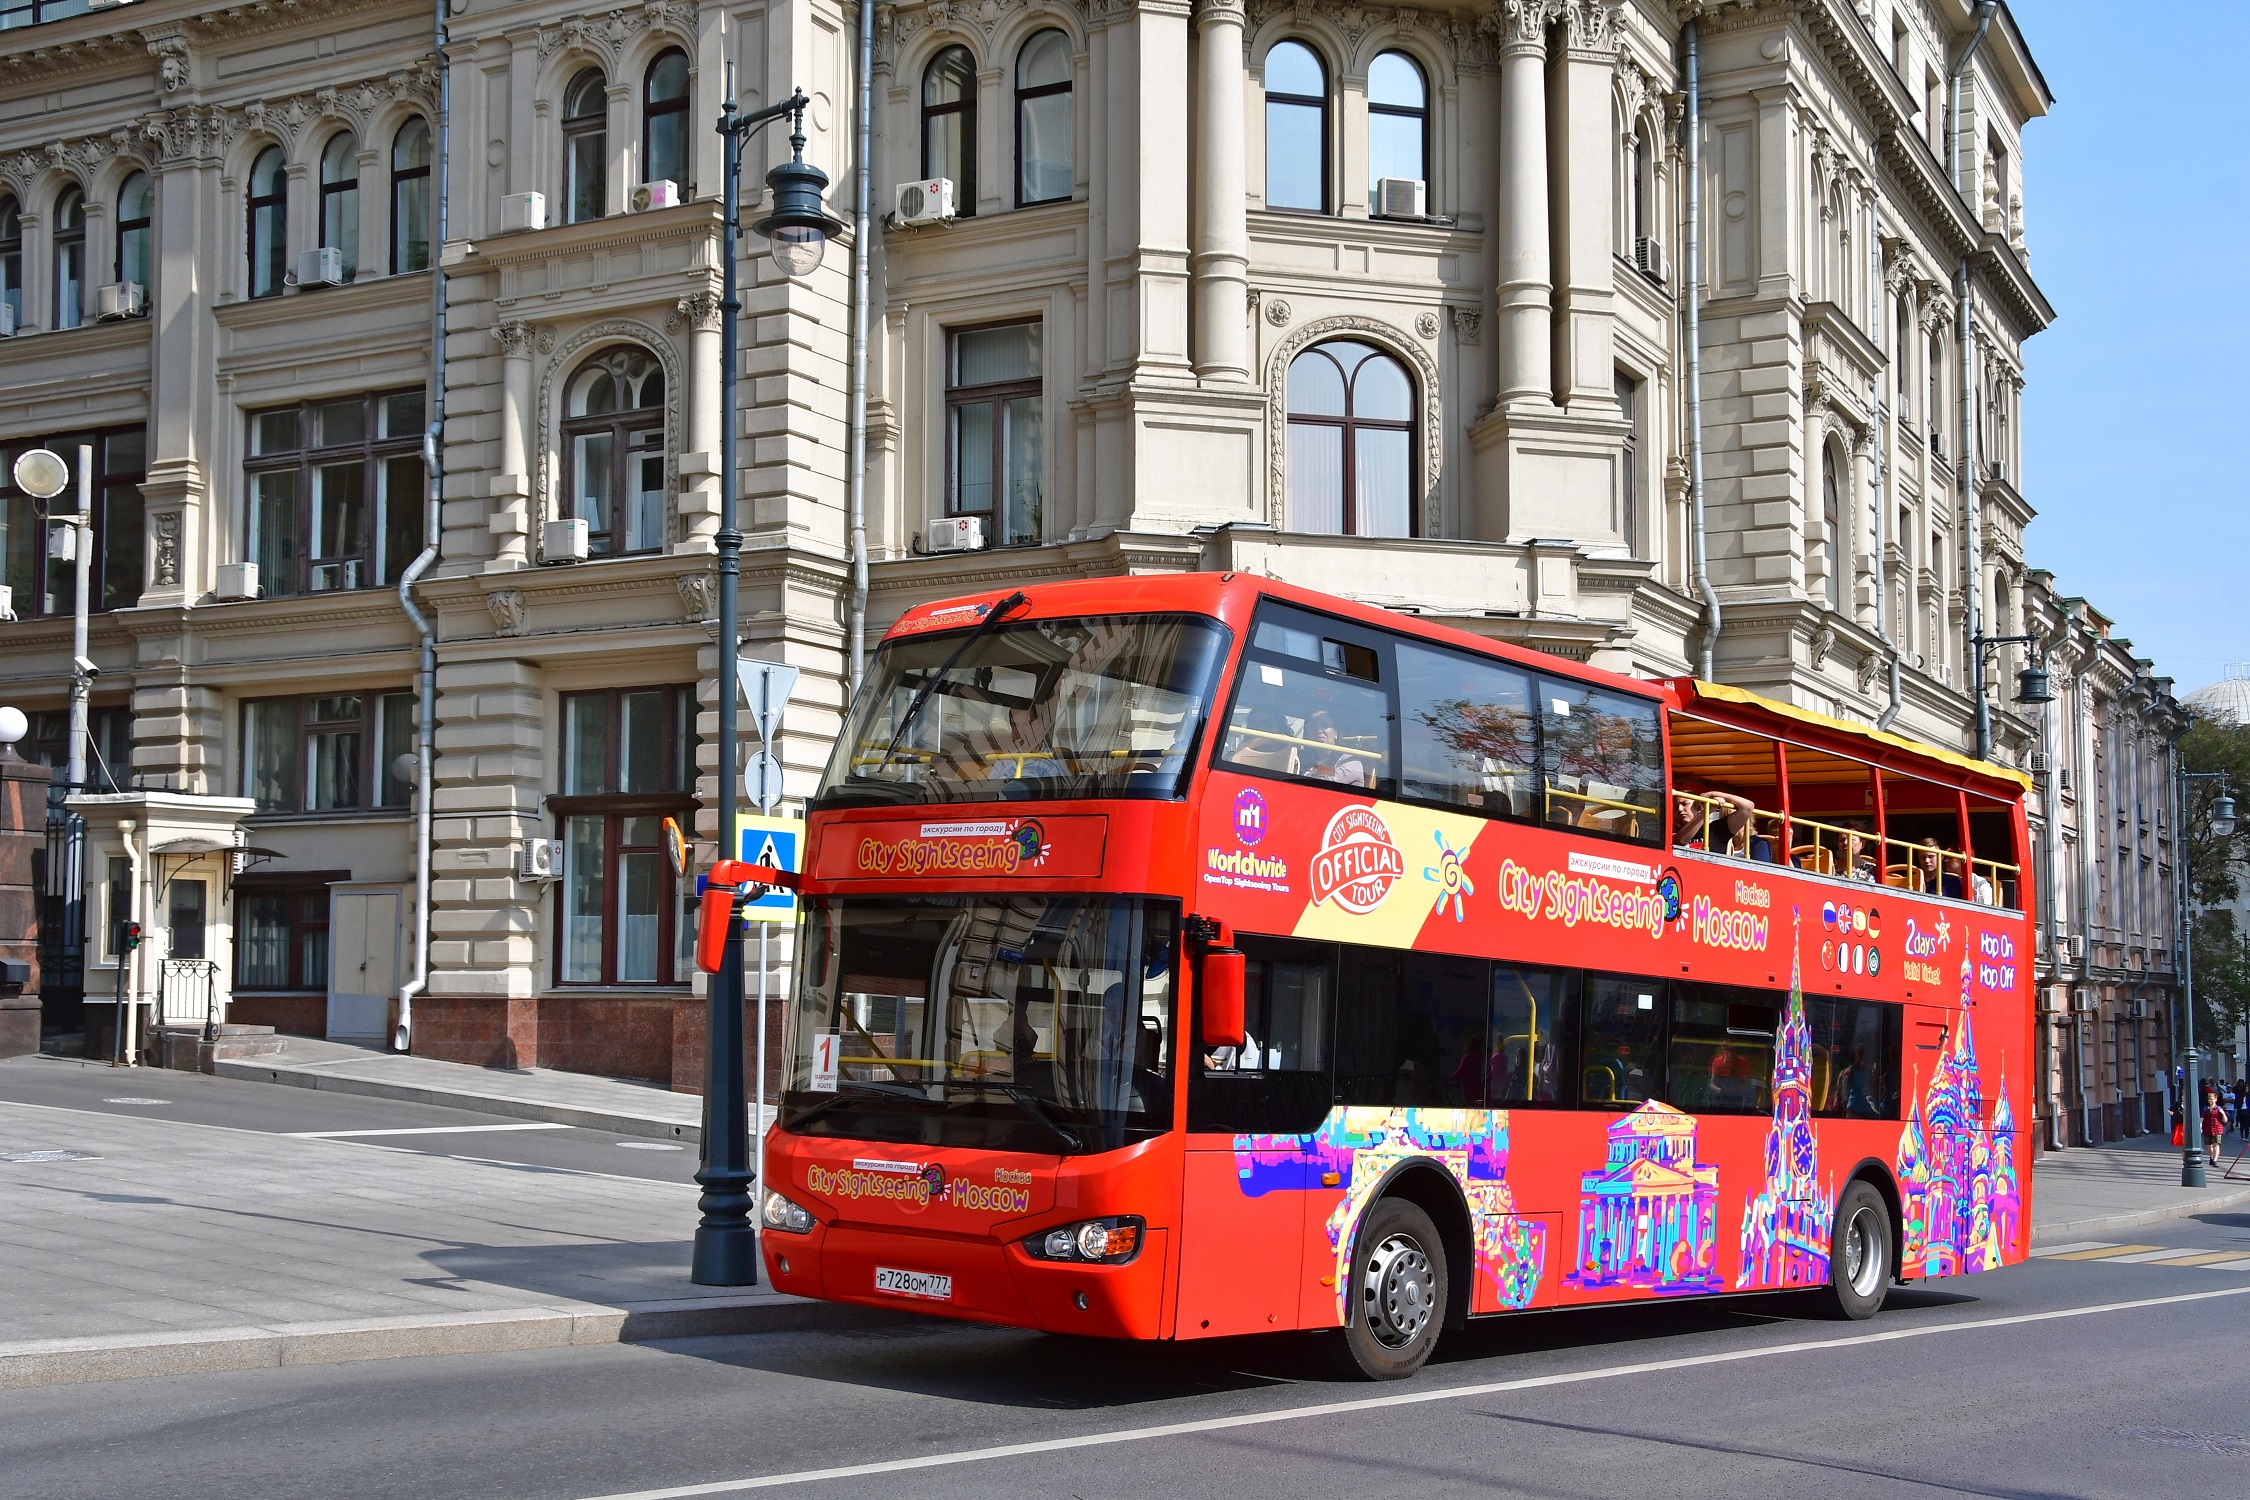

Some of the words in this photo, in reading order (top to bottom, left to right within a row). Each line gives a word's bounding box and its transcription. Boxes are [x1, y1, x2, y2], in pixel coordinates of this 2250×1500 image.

[922, 825, 962, 835] экскурсии
[976, 824, 1004, 834] городу
[1332, 820, 1346, 843] CITY
[1345, 811, 1388, 841] SIGHTSEEING
[858, 837, 897, 874] City
[897, 838, 1021, 875] Sightseeing
[1207, 848, 1287, 878] Worldwide
[1318, 845, 1402, 891] OFFICIAL
[1570, 857, 1611, 872] экскурсии
[1612, 864, 1622, 873] по
[1622, 866, 1649, 880] городу
[1233, 877, 1272, 892] Sightseeing
[1271, 882, 1290, 893] Tours
[1351, 878, 1386, 905] TOUR
[1735, 879, 1771, 909] Москва
[1499, 858, 1545, 920] City
[1545, 869, 1666, 940] Sightseeing
[1980, 932, 1999, 959] Hop
[2000, 934, 2013, 958] On
[1903, 960, 1921, 981] Valid
[1979, 963, 1998, 990] Hop
[1999, 964, 2015, 989] Off
[819, 1036, 831, 1073] 1
[854, 1160, 885, 1169] экскурсии
[994, 1167, 1032, 1185] Москва
[807, 1164, 836, 1195] City
[837, 1168, 930, 1205] Sightseeing
